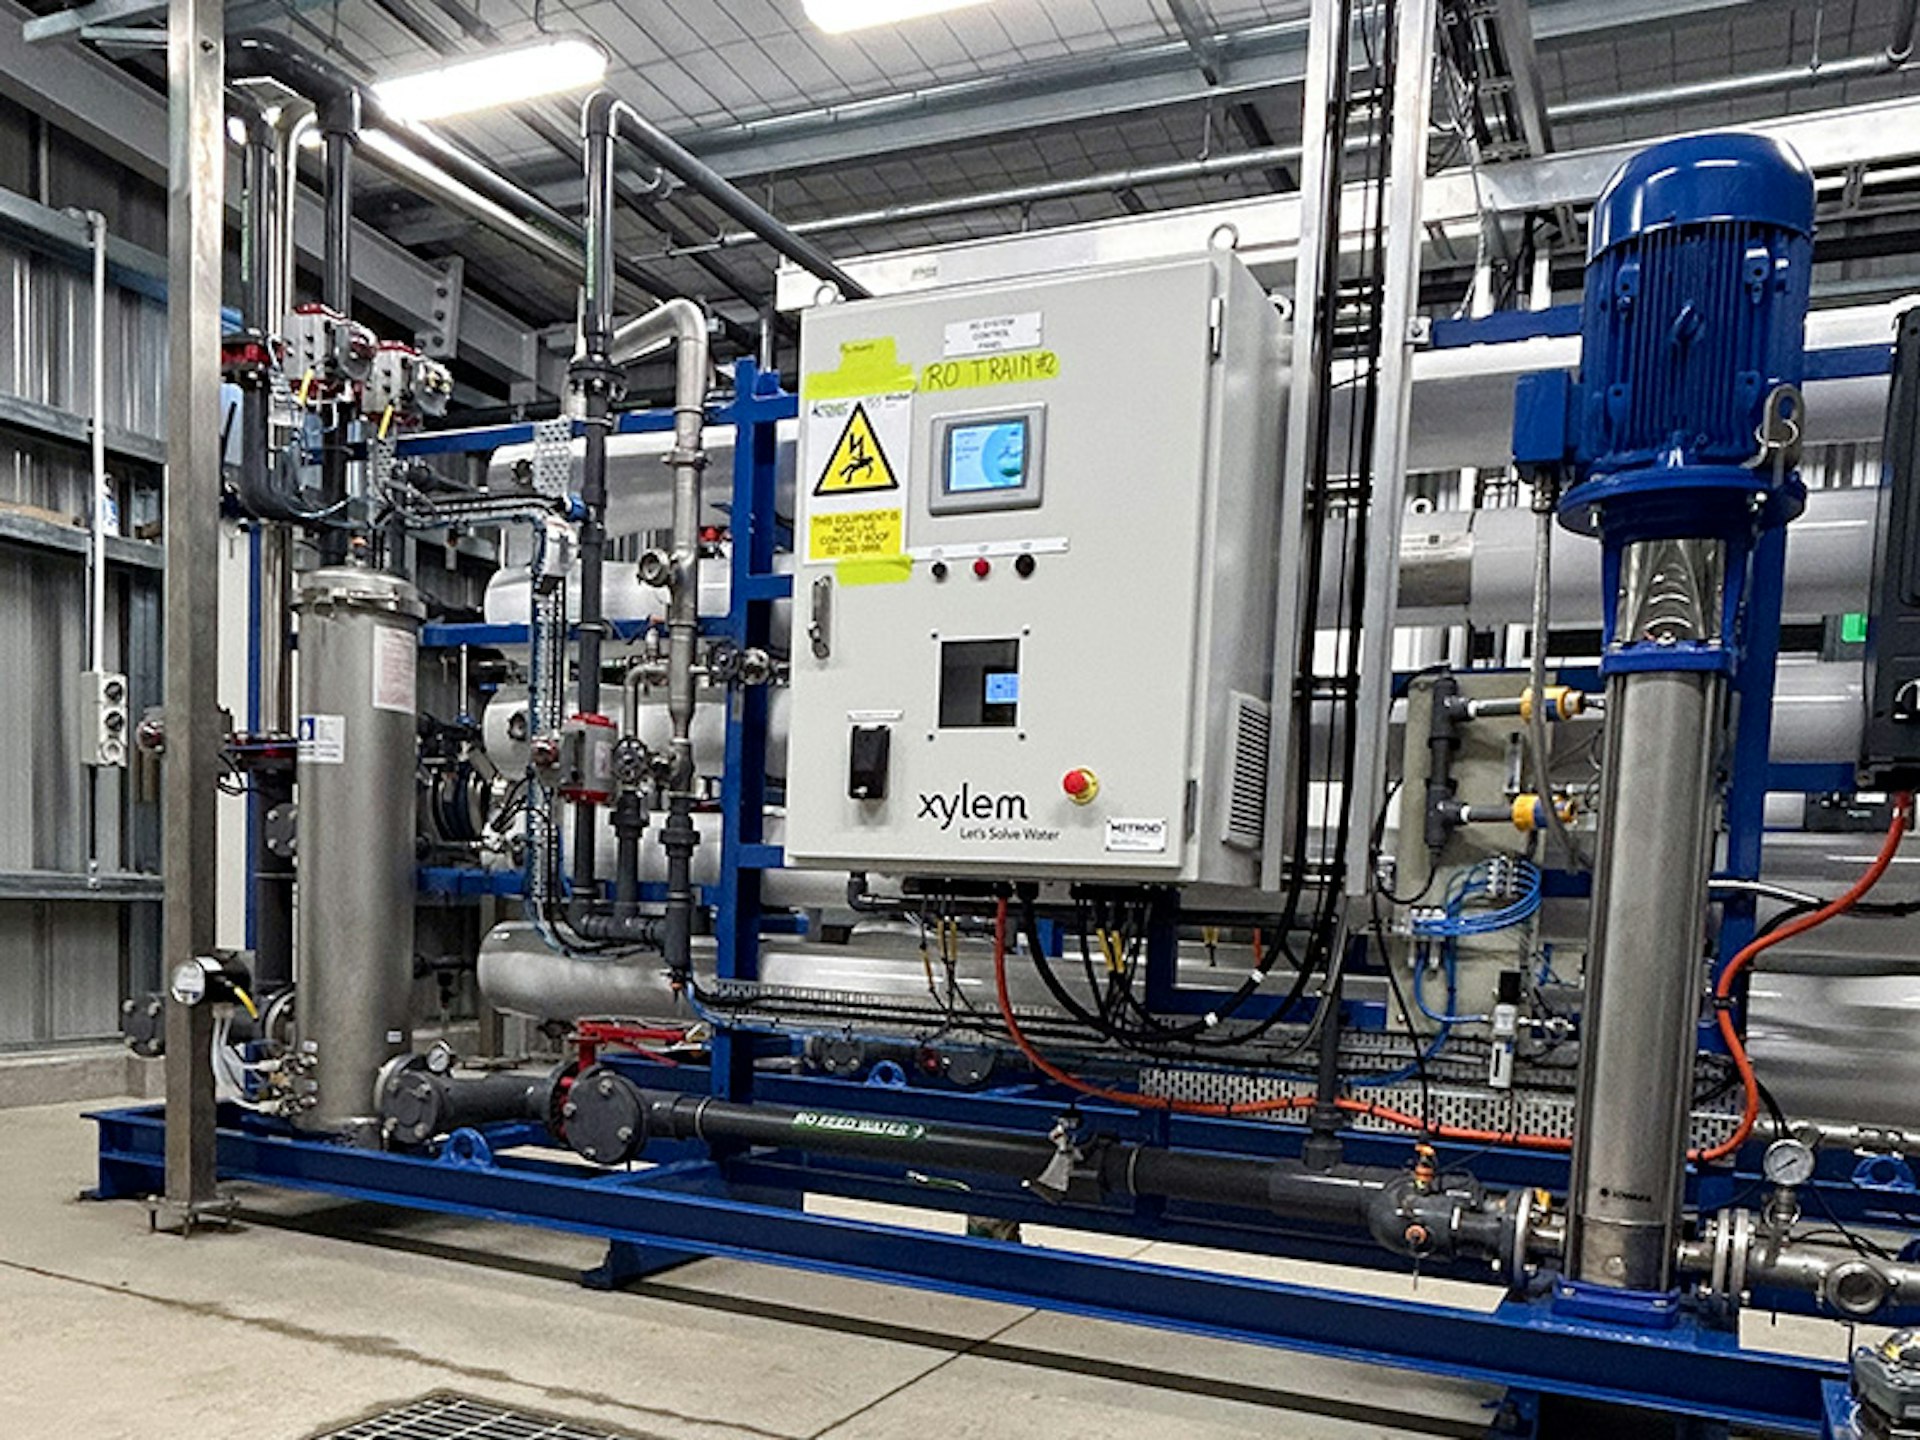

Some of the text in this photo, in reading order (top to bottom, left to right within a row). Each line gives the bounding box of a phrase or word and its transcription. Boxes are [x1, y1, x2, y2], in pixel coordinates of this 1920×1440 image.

[972, 330, 1009, 341] CONTROL
[926, 362, 959, 390] RO
[971, 354, 1032, 382] TRAIN
[835, 511, 888, 524] EQUIPMENT
[820, 533, 863, 545] CONTACT
[918, 782, 1028, 830] xylem
[960, 827, 1060, 840] Let's Solve Water
[817, 1114, 858, 1131] FEED
[859, 1119, 909, 1137] WATER
